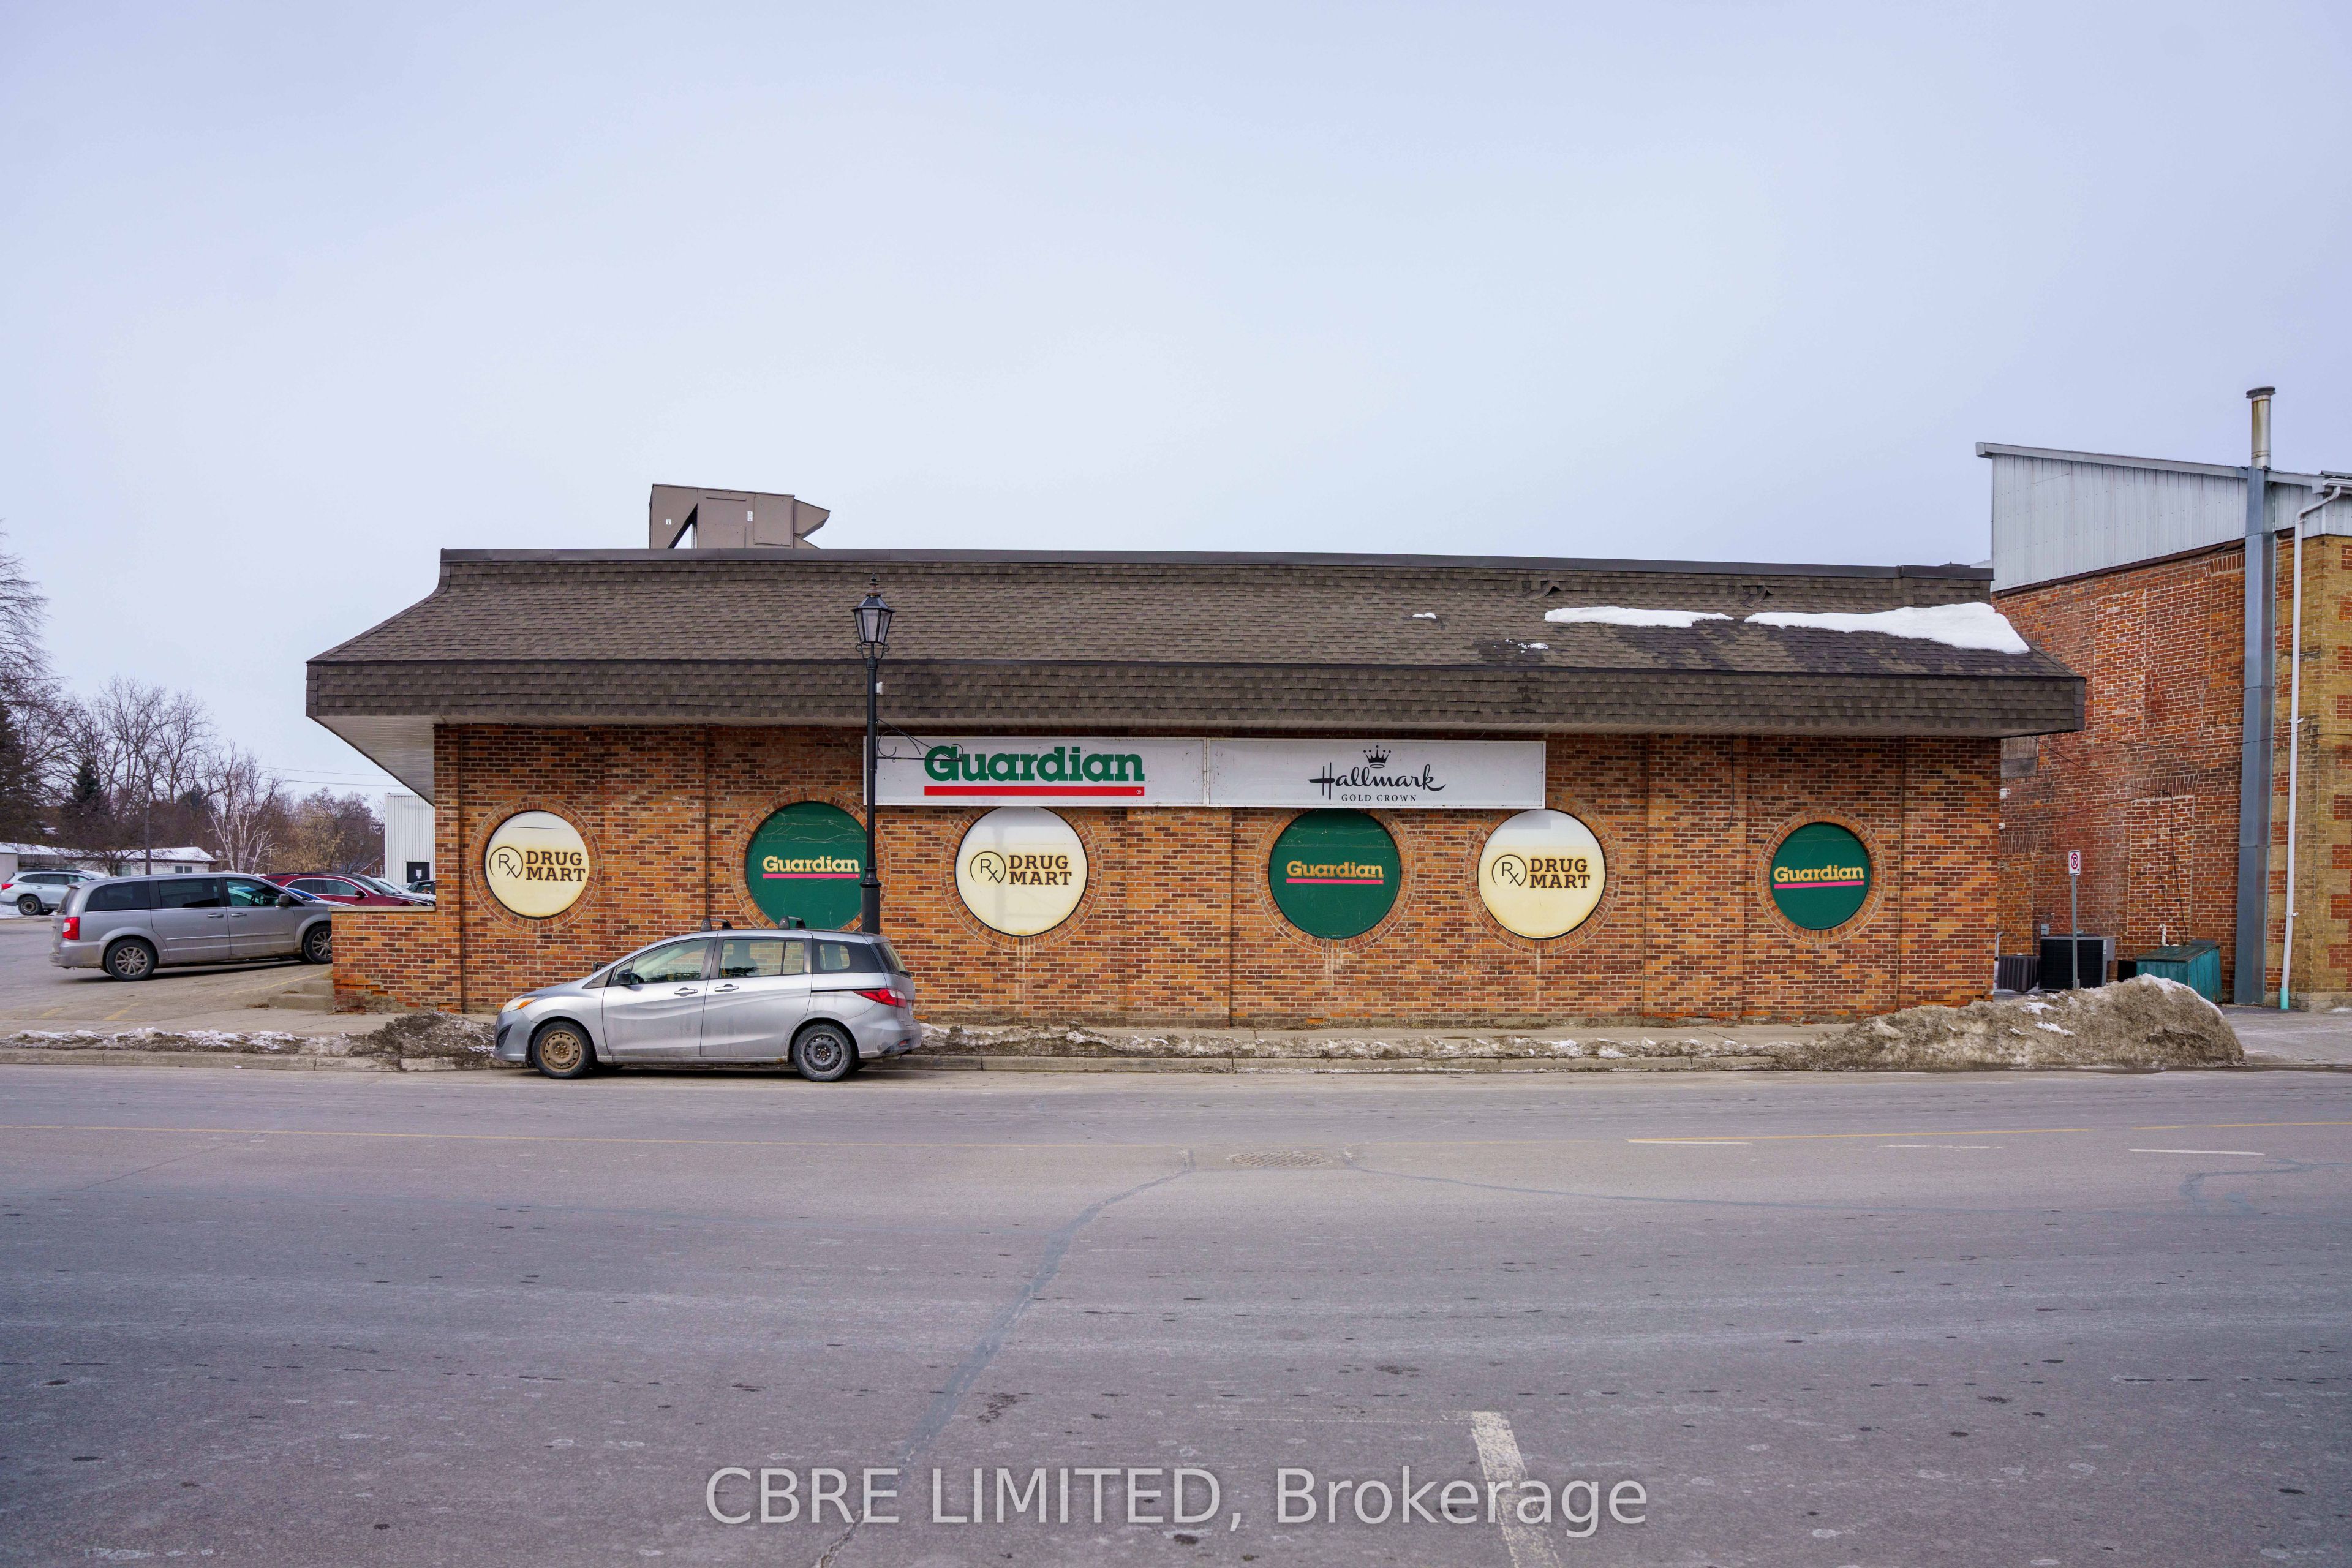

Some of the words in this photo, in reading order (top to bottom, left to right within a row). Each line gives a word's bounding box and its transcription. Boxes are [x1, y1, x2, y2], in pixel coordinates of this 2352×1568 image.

[924, 745, 1145, 782] Guardian
[1307, 762, 1447, 801] Hallmark
[526, 851, 582, 866] DRUG
[763, 856, 860, 872] Guardian
[1009, 854, 1069, 869] DRUG
[1529, 858, 1588, 873] DRUG
[526, 867, 586, 882] MART
[1286, 860, 1384, 878] Guardian
[1774, 864, 1864, 883] Guardian
[1009, 871, 1072, 886] MART
[1529, 874, 1591, 888] MART
